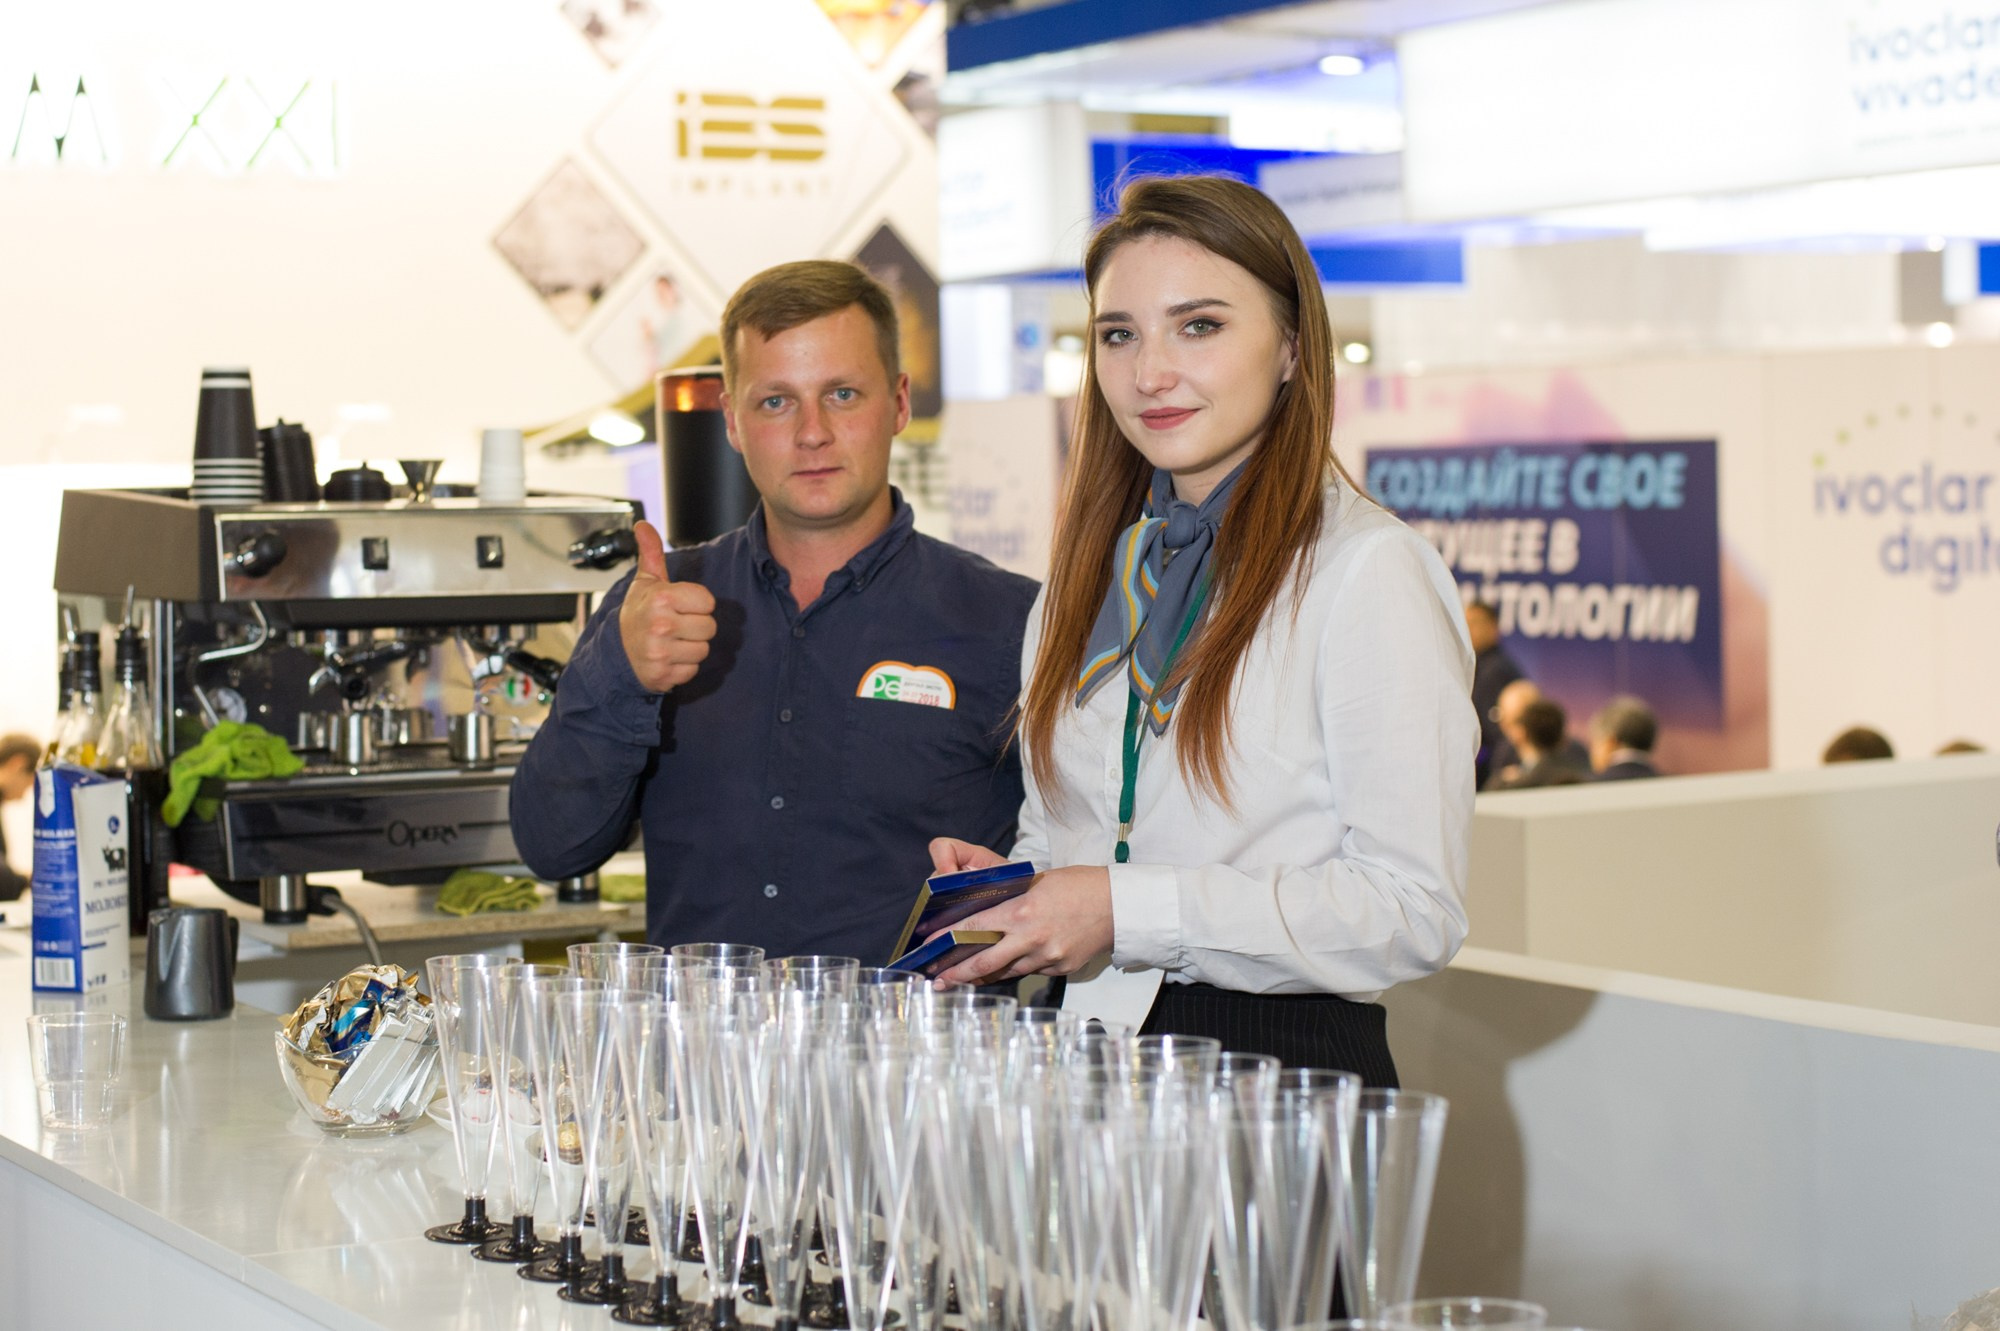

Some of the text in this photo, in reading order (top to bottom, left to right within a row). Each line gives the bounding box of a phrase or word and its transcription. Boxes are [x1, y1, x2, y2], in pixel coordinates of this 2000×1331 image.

[1368, 448, 1687, 517] СОЗДАЙТЕ СВОЕ
[1813, 460, 1994, 515] ivoclar
[1548, 518, 1580, 574] В
[1878, 524, 2000, 597] digit
[1462, 582, 1698, 642] ТОЛОГИИ
